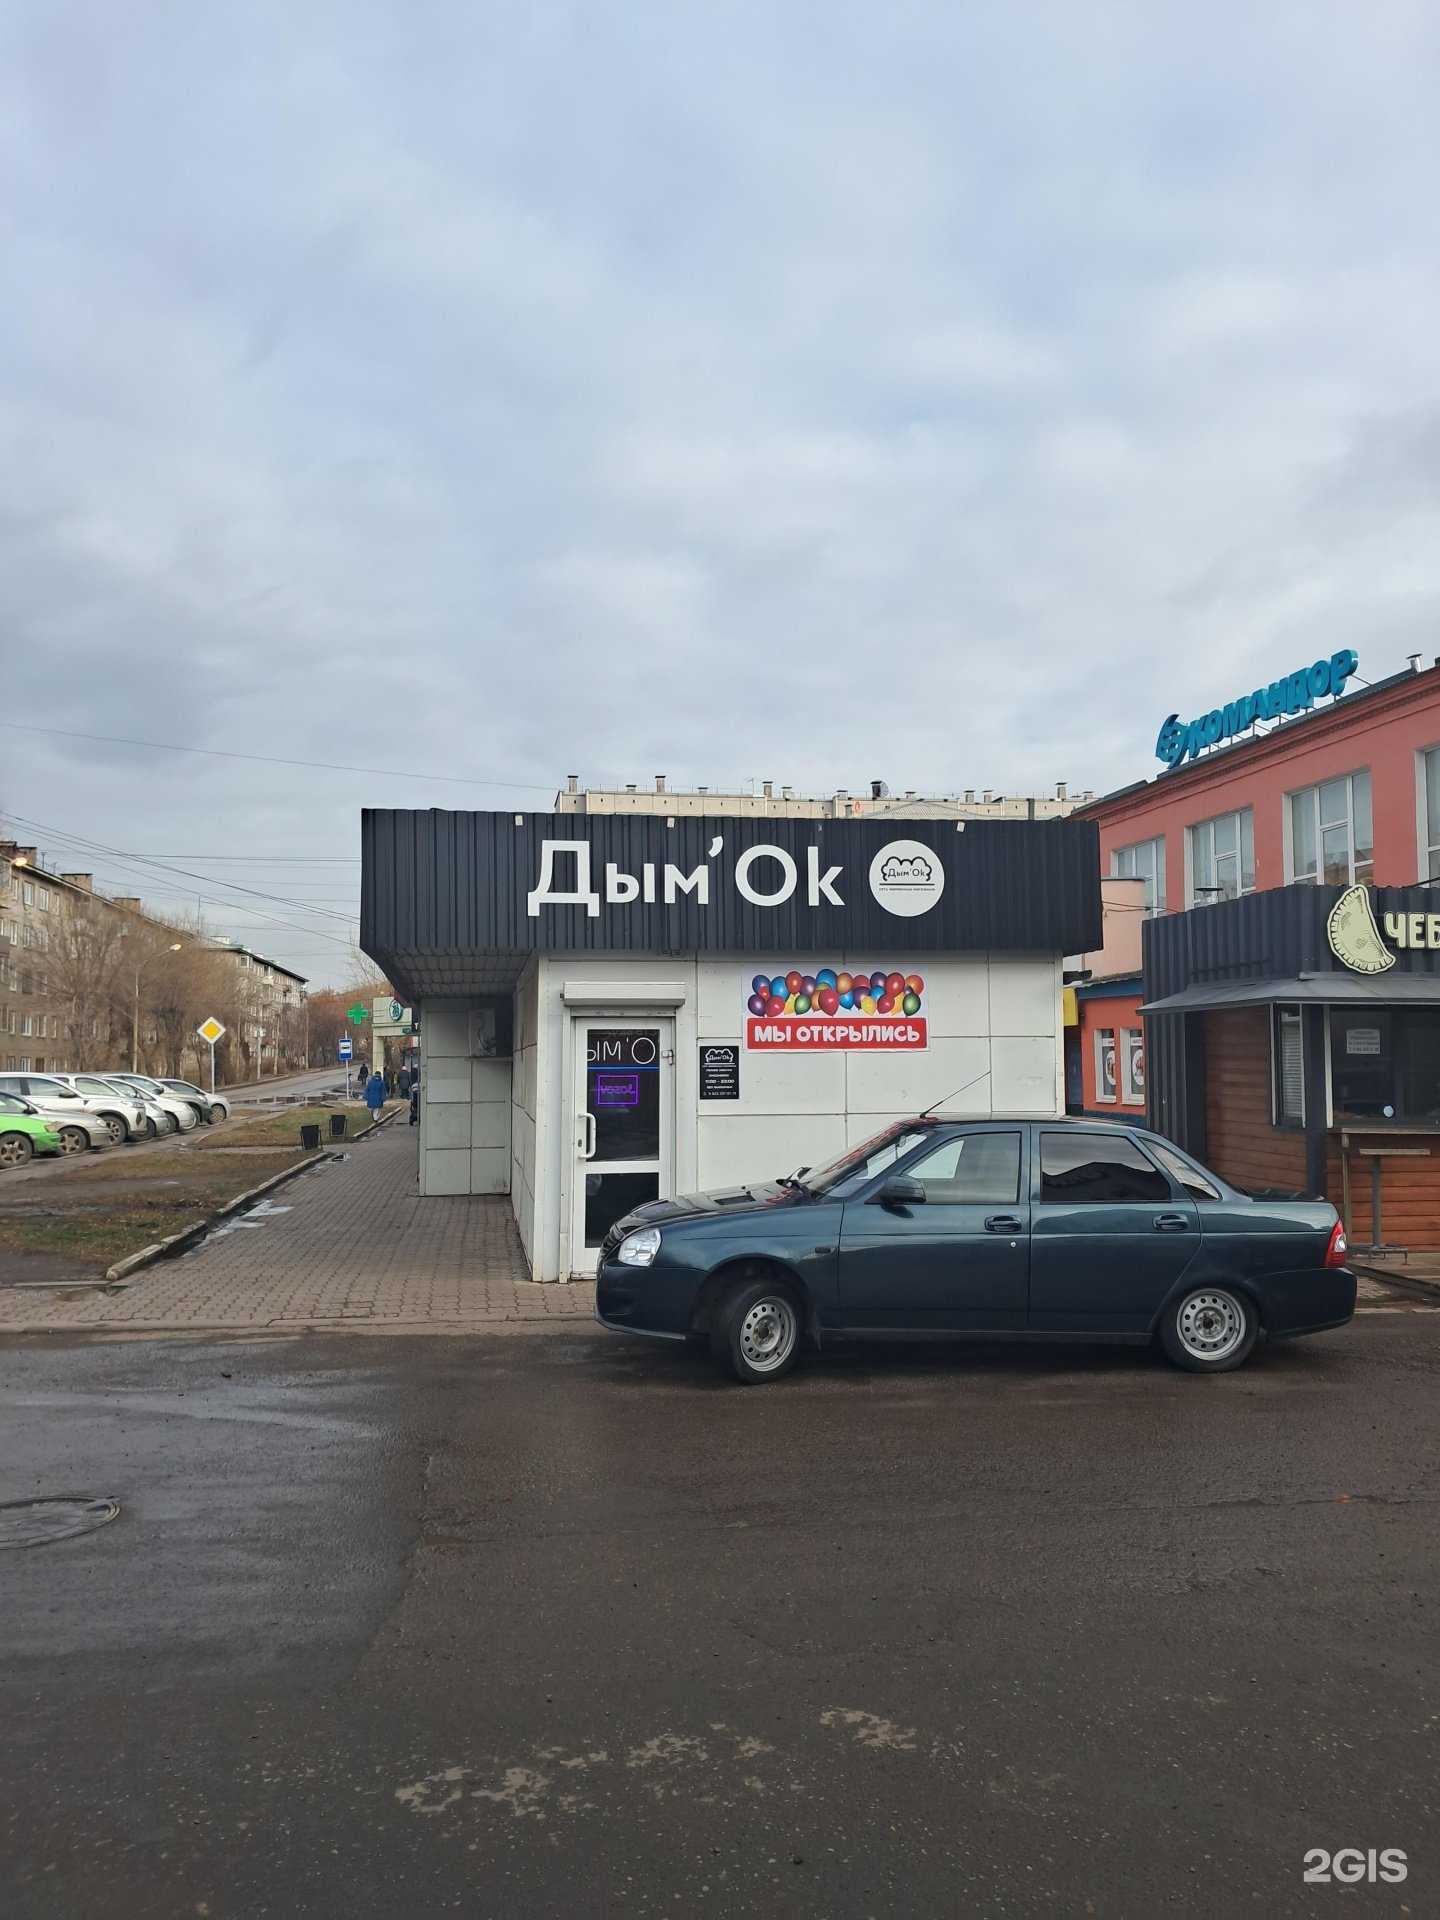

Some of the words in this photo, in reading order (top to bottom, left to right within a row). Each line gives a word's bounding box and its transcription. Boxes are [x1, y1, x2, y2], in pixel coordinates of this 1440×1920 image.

[1188, 649, 1358, 759] КОМАНДОР
[754, 1025, 792, 1042] МЫ
[796, 1025, 920, 1042] ОТКРЫЛИСЬ
